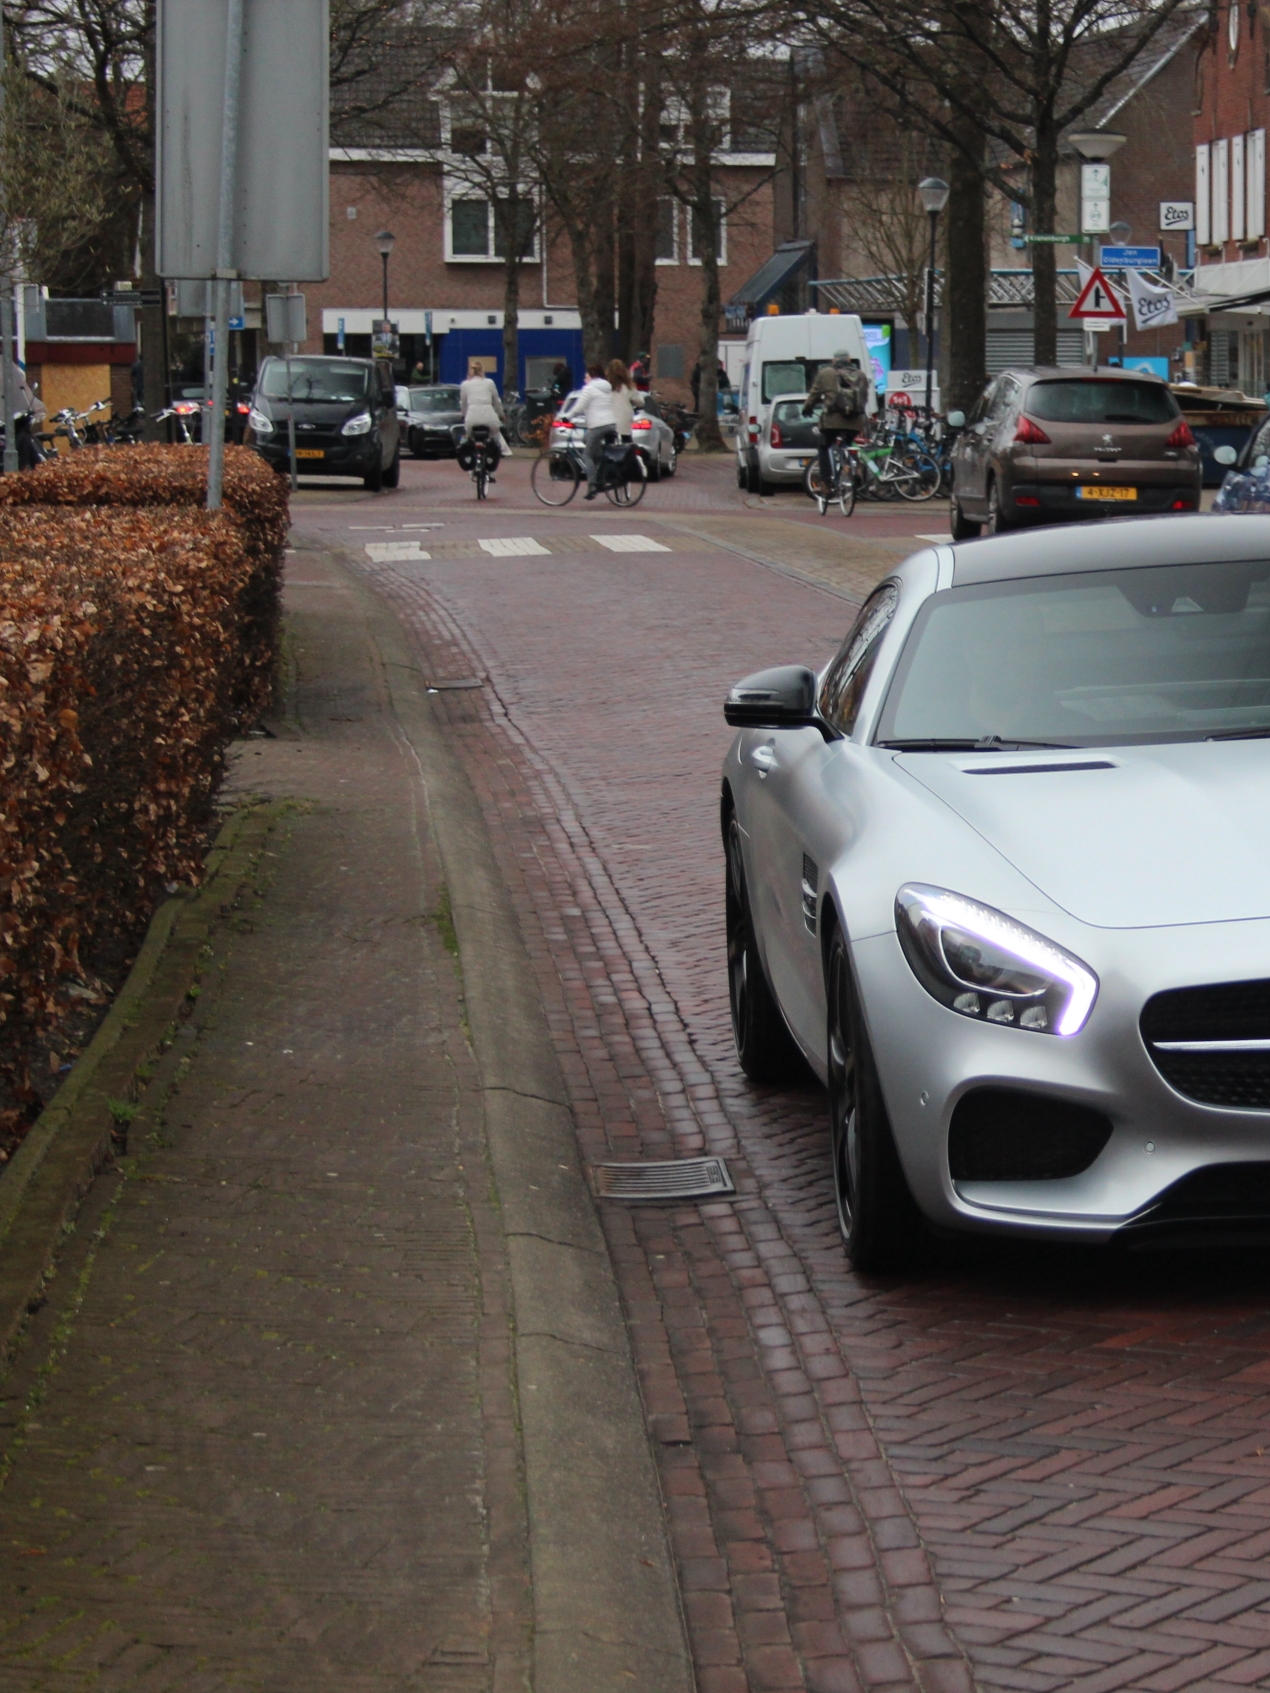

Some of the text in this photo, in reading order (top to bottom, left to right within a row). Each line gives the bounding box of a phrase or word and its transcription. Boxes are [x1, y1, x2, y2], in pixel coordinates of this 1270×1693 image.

[1165, 206, 1189, 221] Etos
[1138, 297, 1171, 316] Etos
[902, 372, 922, 384] Etos
